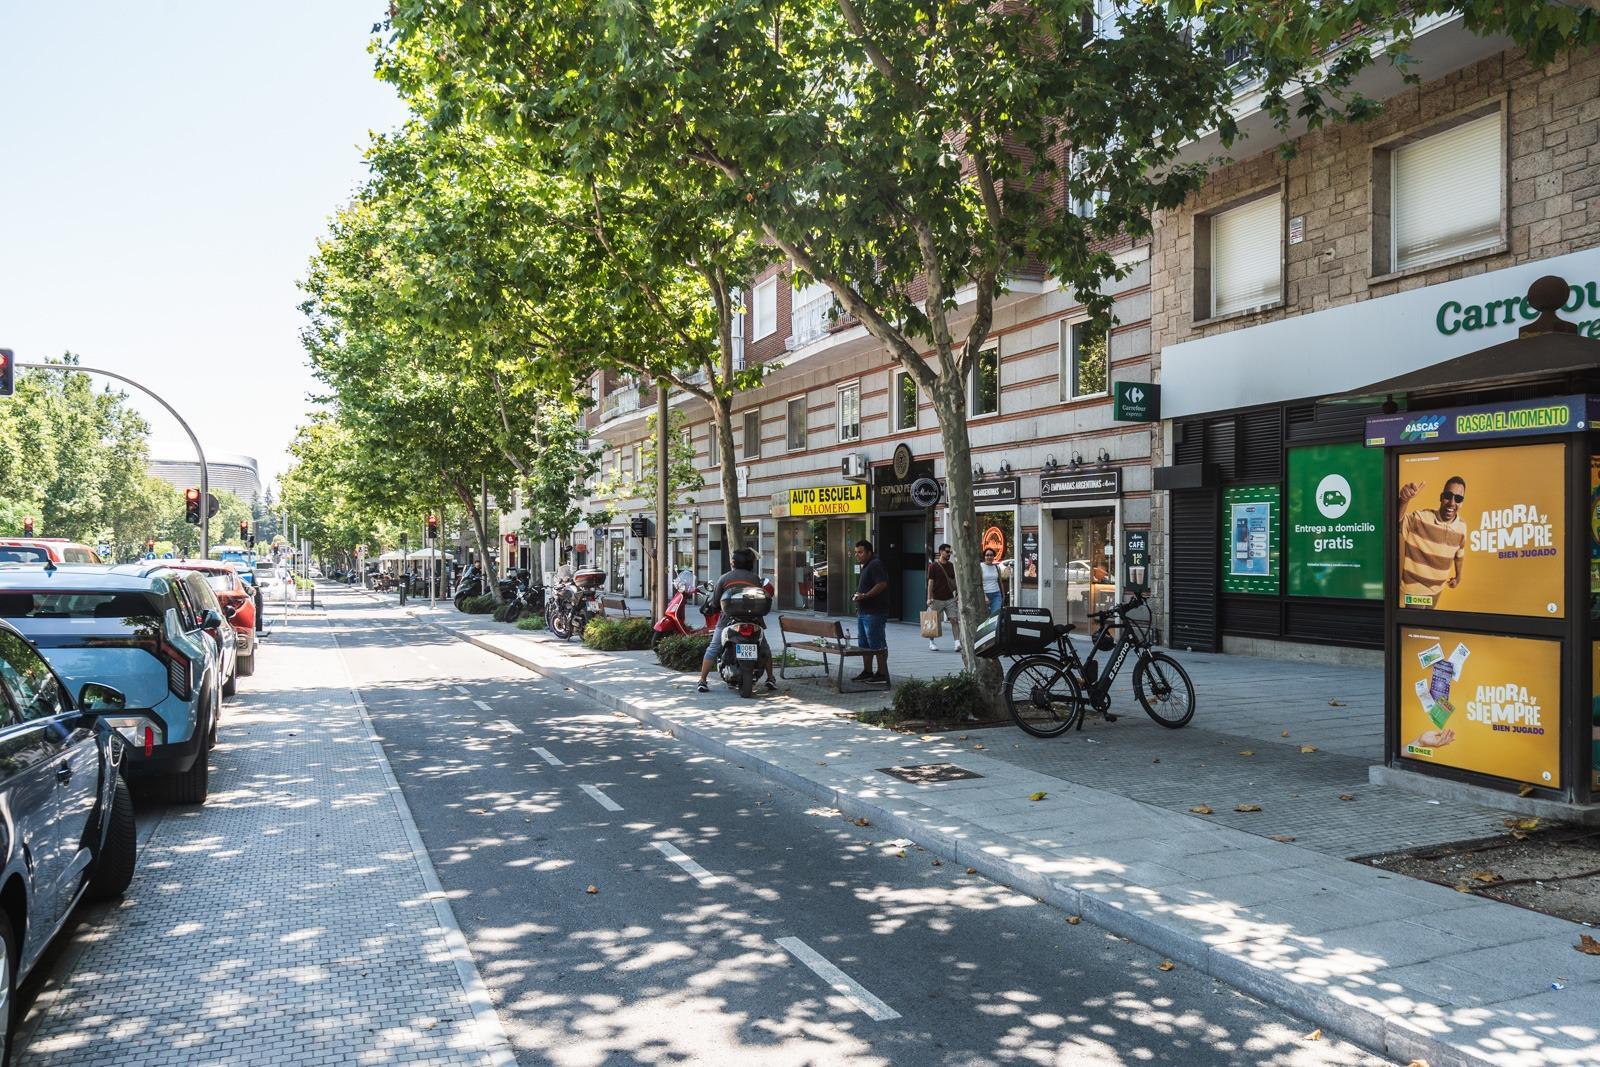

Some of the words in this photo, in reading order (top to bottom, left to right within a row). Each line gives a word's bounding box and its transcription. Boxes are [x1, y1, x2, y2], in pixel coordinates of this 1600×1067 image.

[1436, 281, 1600, 336] Carreou
[1405, 421, 1439, 433] RASCAS
[1457, 415, 1492, 434] RASCA
[1495, 413, 1508, 431] EL
[1508, 405, 1569, 429] MOMENTO
[792, 489, 816, 504] AUTO
[819, 485, 862, 503] ESCUELA
[803, 502, 850, 515] PALOMERO
[1480, 504, 1539, 530] AHORA
[1295, 524, 1326, 534] Entrega
[1335, 522, 1375, 532] domicilio
[1128, 540, 1145, 548] CAFÉ
[1314, 535, 1354, 552] gratis
[1470, 523, 1553, 553] SIEMPRE
[1498, 549, 1518, 559] BIEN
[1520, 548, 1557, 558] JUGADO
[1111, 642, 1130, 672] zoomo
[1476, 683, 1529, 703] AHORA
[1467, 701, 1542, 726] SIEMPRE
[1493, 724, 1510, 732] BIEN
[1512, 726, 1545, 735] JUGADO
[1414, 747, 1431, 756] ONCE
